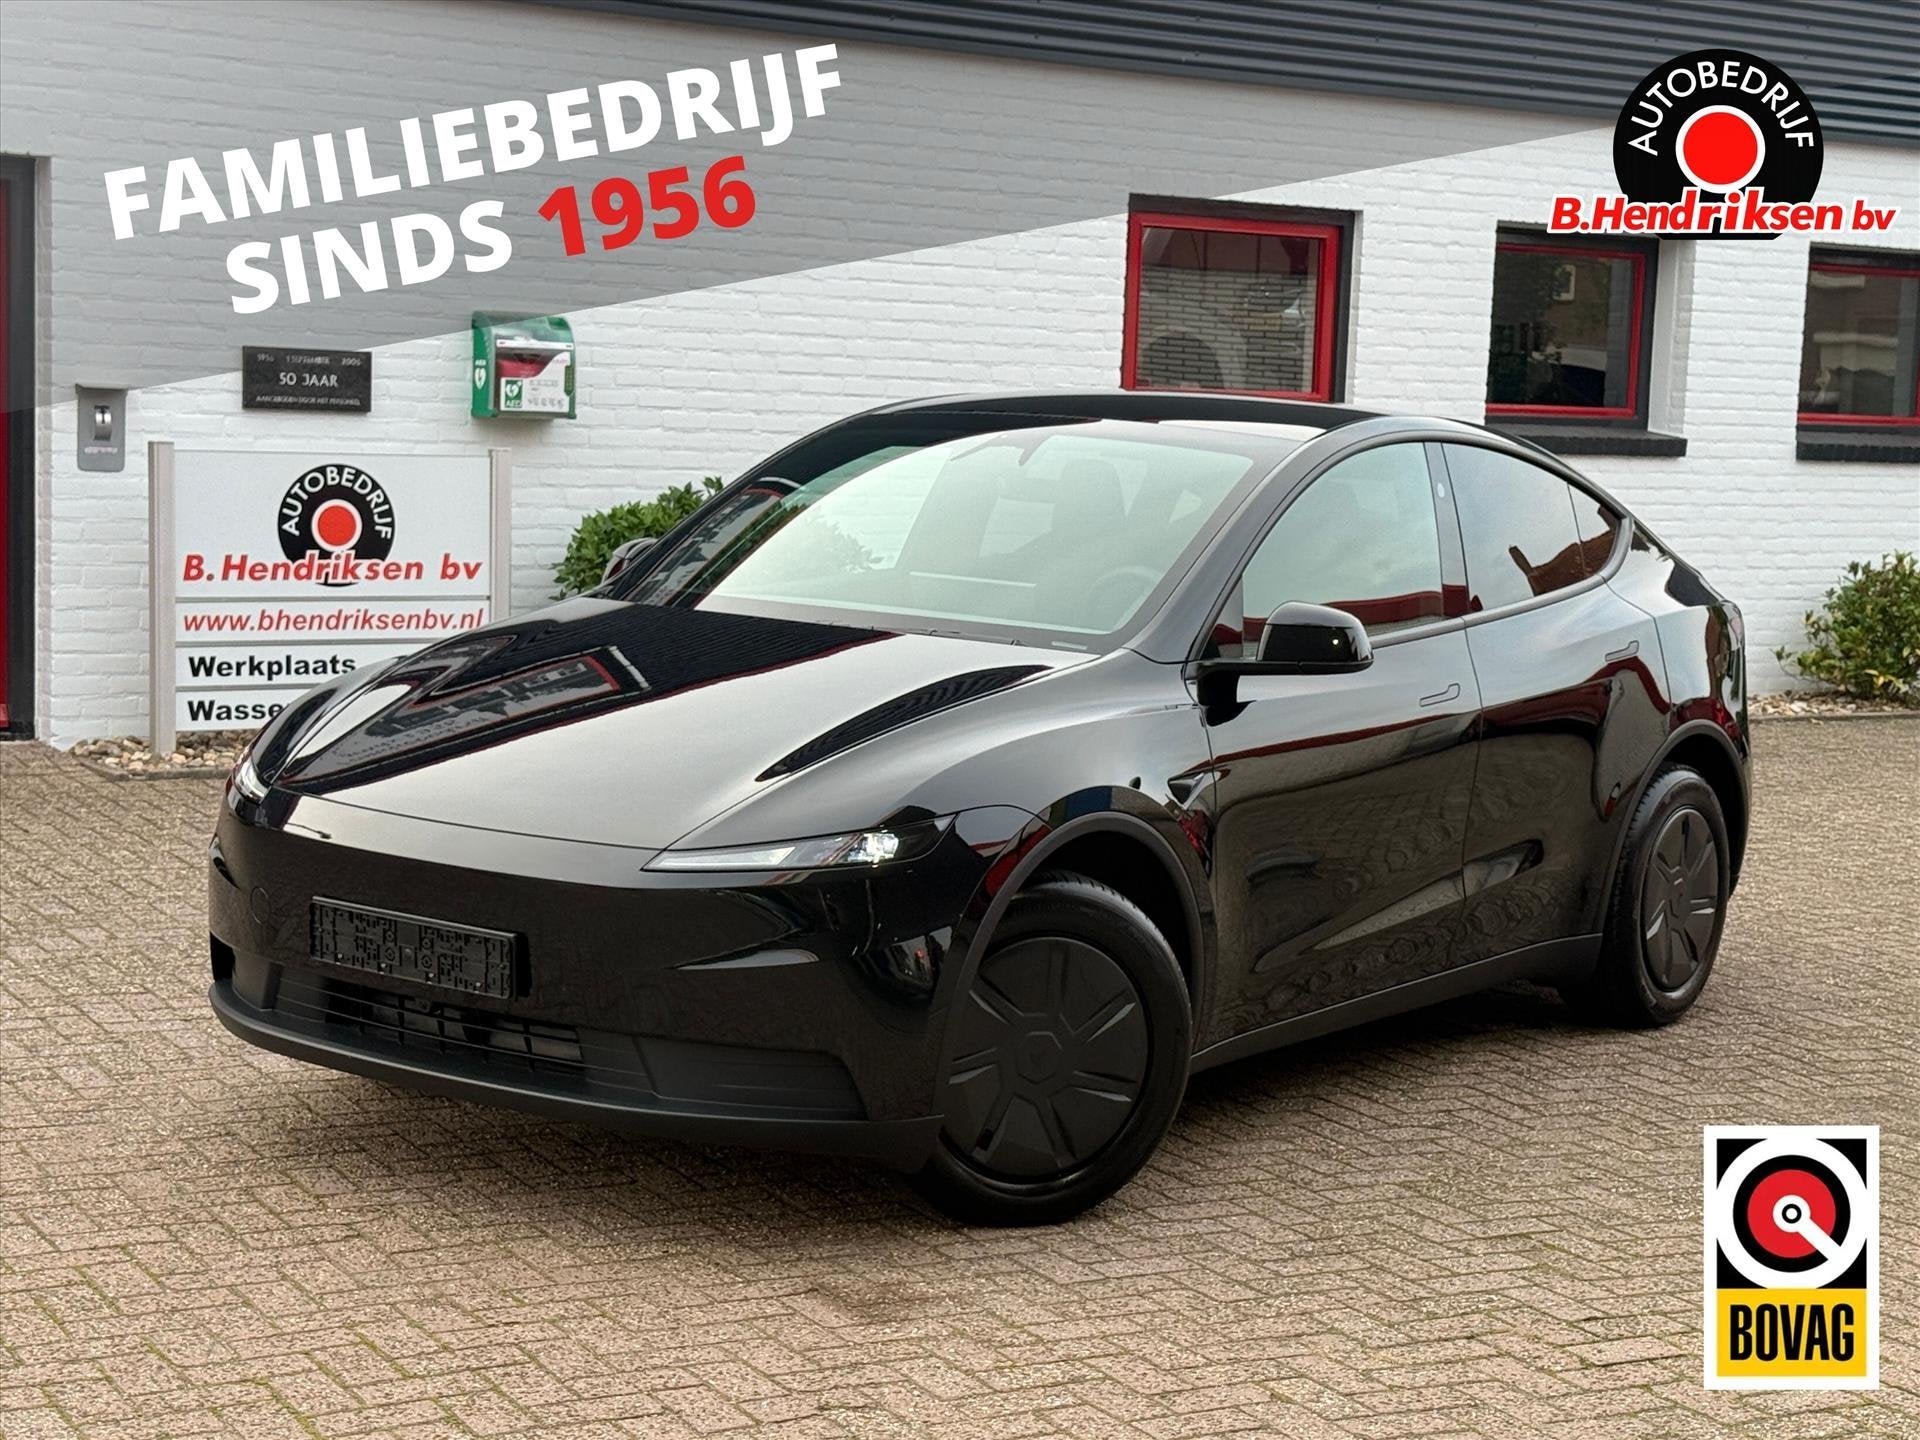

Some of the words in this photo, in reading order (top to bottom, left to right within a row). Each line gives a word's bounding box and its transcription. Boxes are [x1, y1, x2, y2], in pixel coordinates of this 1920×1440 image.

[279, 372, 297, 385] 50
[302, 373, 338, 387] JAAR
[281, 466, 393, 539] AUTOBEDRIJF
[440, 553, 483, 580] bv
[183, 608, 484, 631] www.bhendriksenbv.nl
[188, 655, 356, 681] Werkplaats
[187, 699, 290, 722] Wasse
